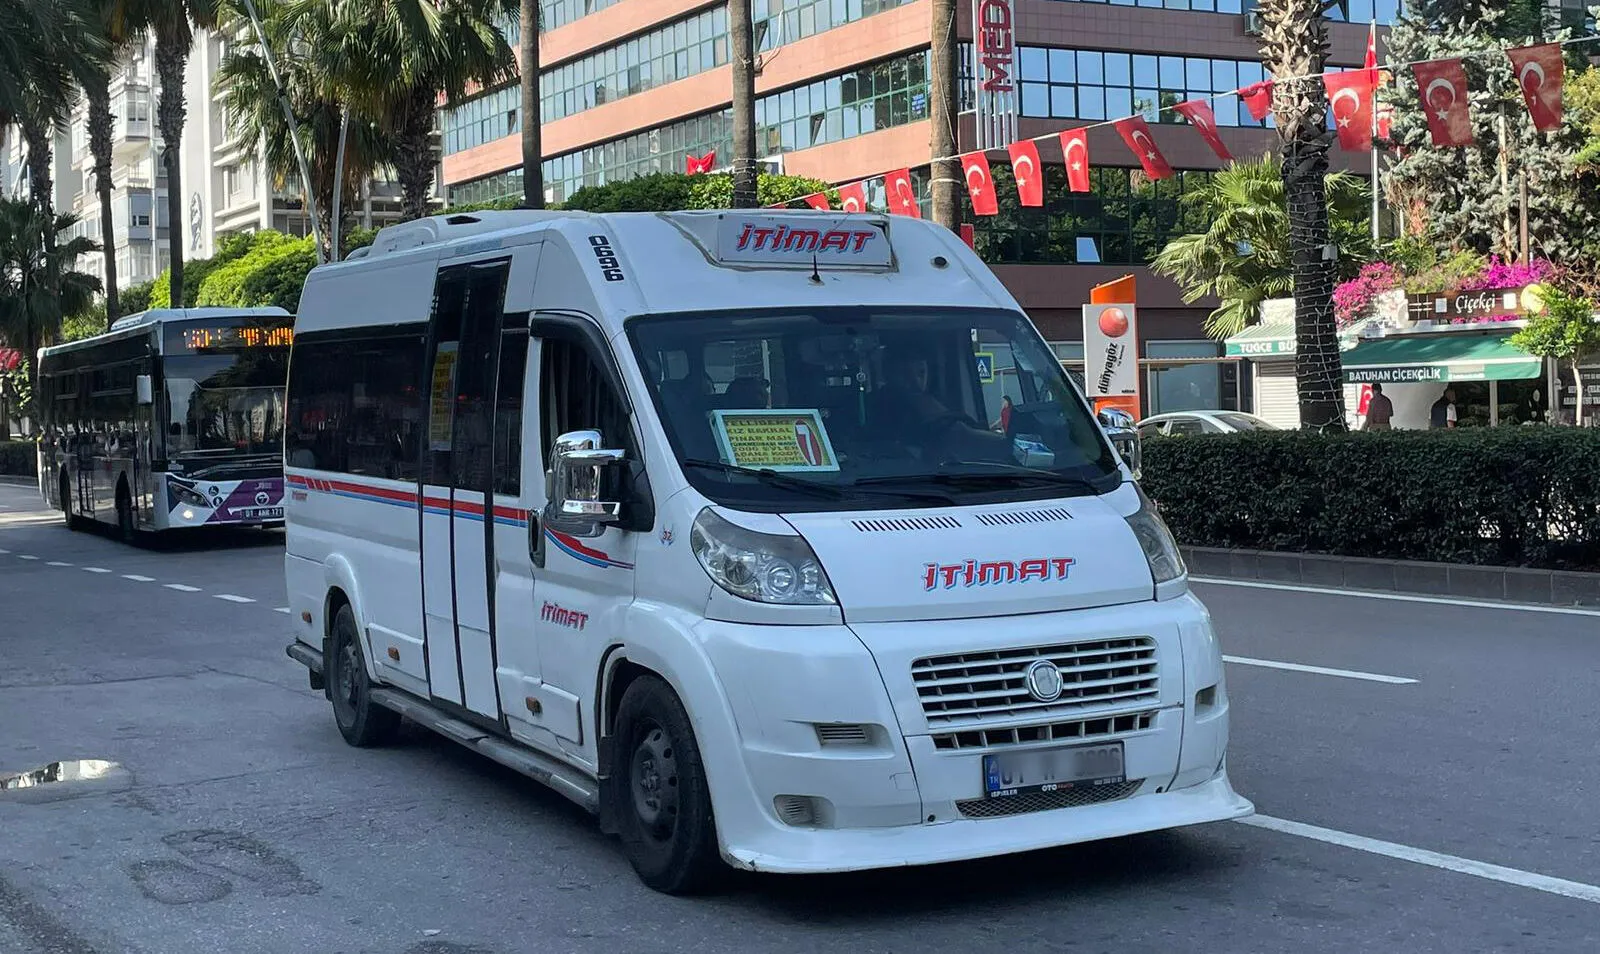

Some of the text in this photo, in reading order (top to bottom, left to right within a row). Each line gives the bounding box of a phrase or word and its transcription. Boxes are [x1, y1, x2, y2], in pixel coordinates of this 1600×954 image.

[736, 222, 876, 253] İTİMAT
[588, 235, 625, 282] 0696
[1455, 291, 1496, 314] Çiçekçi
[1097, 342, 1118, 394] dünyagöz
[1349, 371, 1391, 381] BATUHAN
[1392, 367, 1441, 381] ÇİÇEKÇİLİK
[795, 424, 817, 465] 7
[922, 558, 1077, 592] İTİMAT
[1041, 784, 1058, 792] OTO
